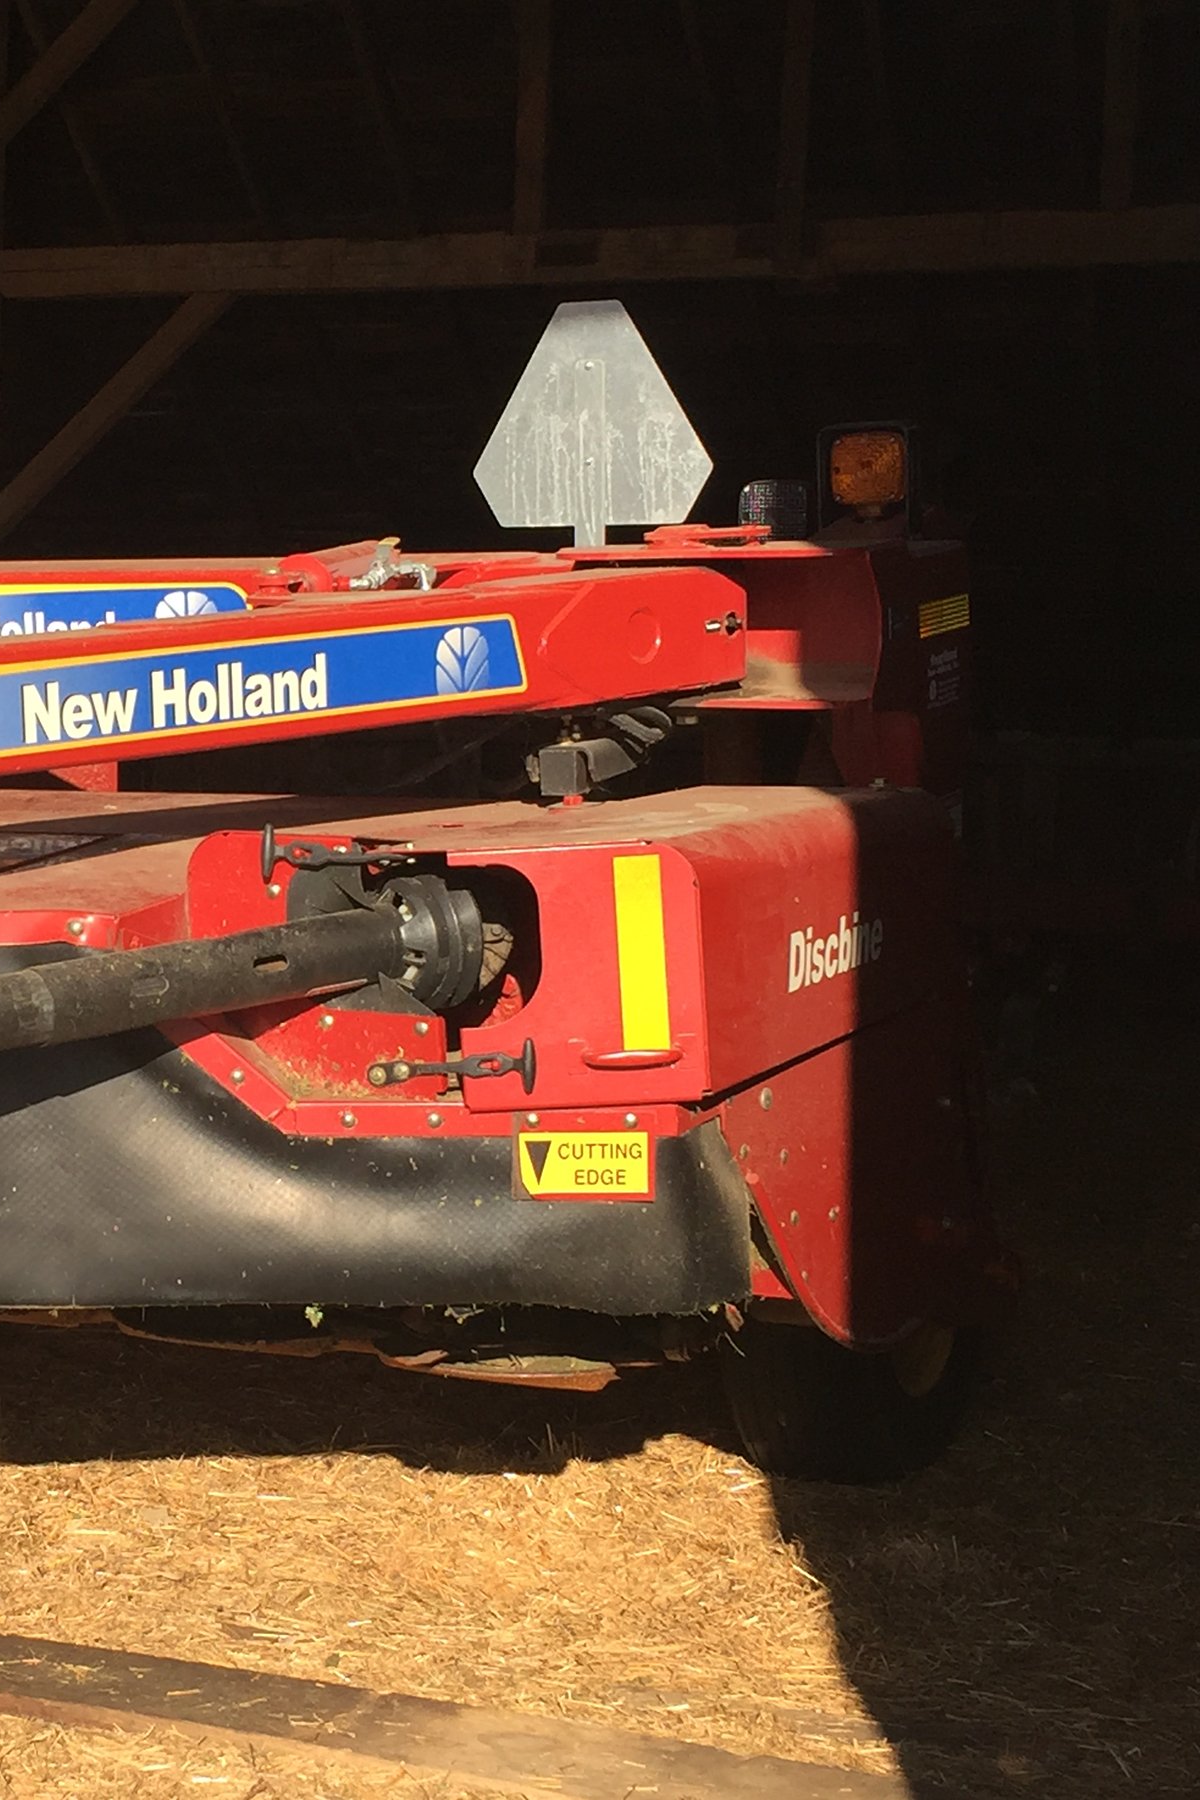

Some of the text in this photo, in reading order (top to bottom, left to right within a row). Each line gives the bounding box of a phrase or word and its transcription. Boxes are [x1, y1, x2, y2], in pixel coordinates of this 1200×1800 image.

[22, 653, 328, 743] New Holland
[788, 911, 883, 993] Discbine
[558, 1143, 642, 1160] CUTTING
[574, 1169, 627, 1185] EDGE
